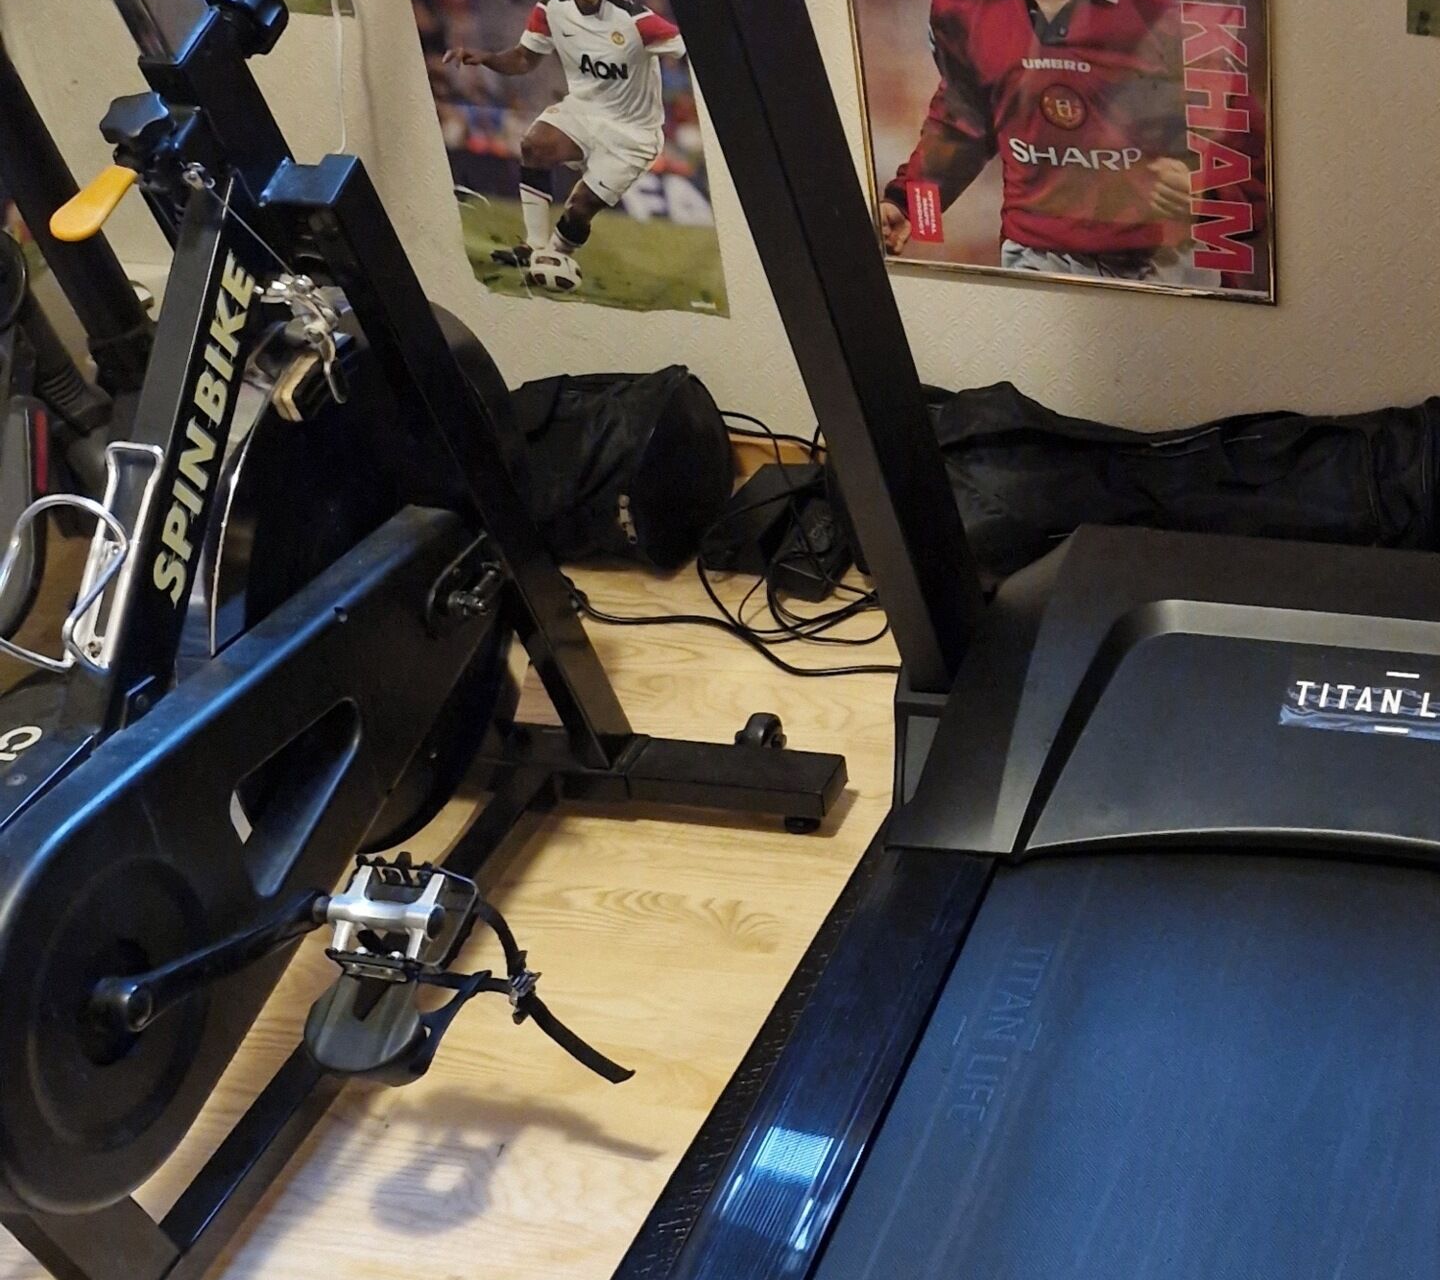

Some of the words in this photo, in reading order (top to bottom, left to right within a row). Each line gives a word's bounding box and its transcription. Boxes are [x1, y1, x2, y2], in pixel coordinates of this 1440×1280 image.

[578, 53, 629, 80] AON
[1021, 57, 1092, 73] UMBRO
[1008, 137, 1142, 171] SHARP
[153, 414, 217, 610] SPIN
[193, 247, 256, 430] BIKE
[1296, 680, 1402, 715] TITAN
